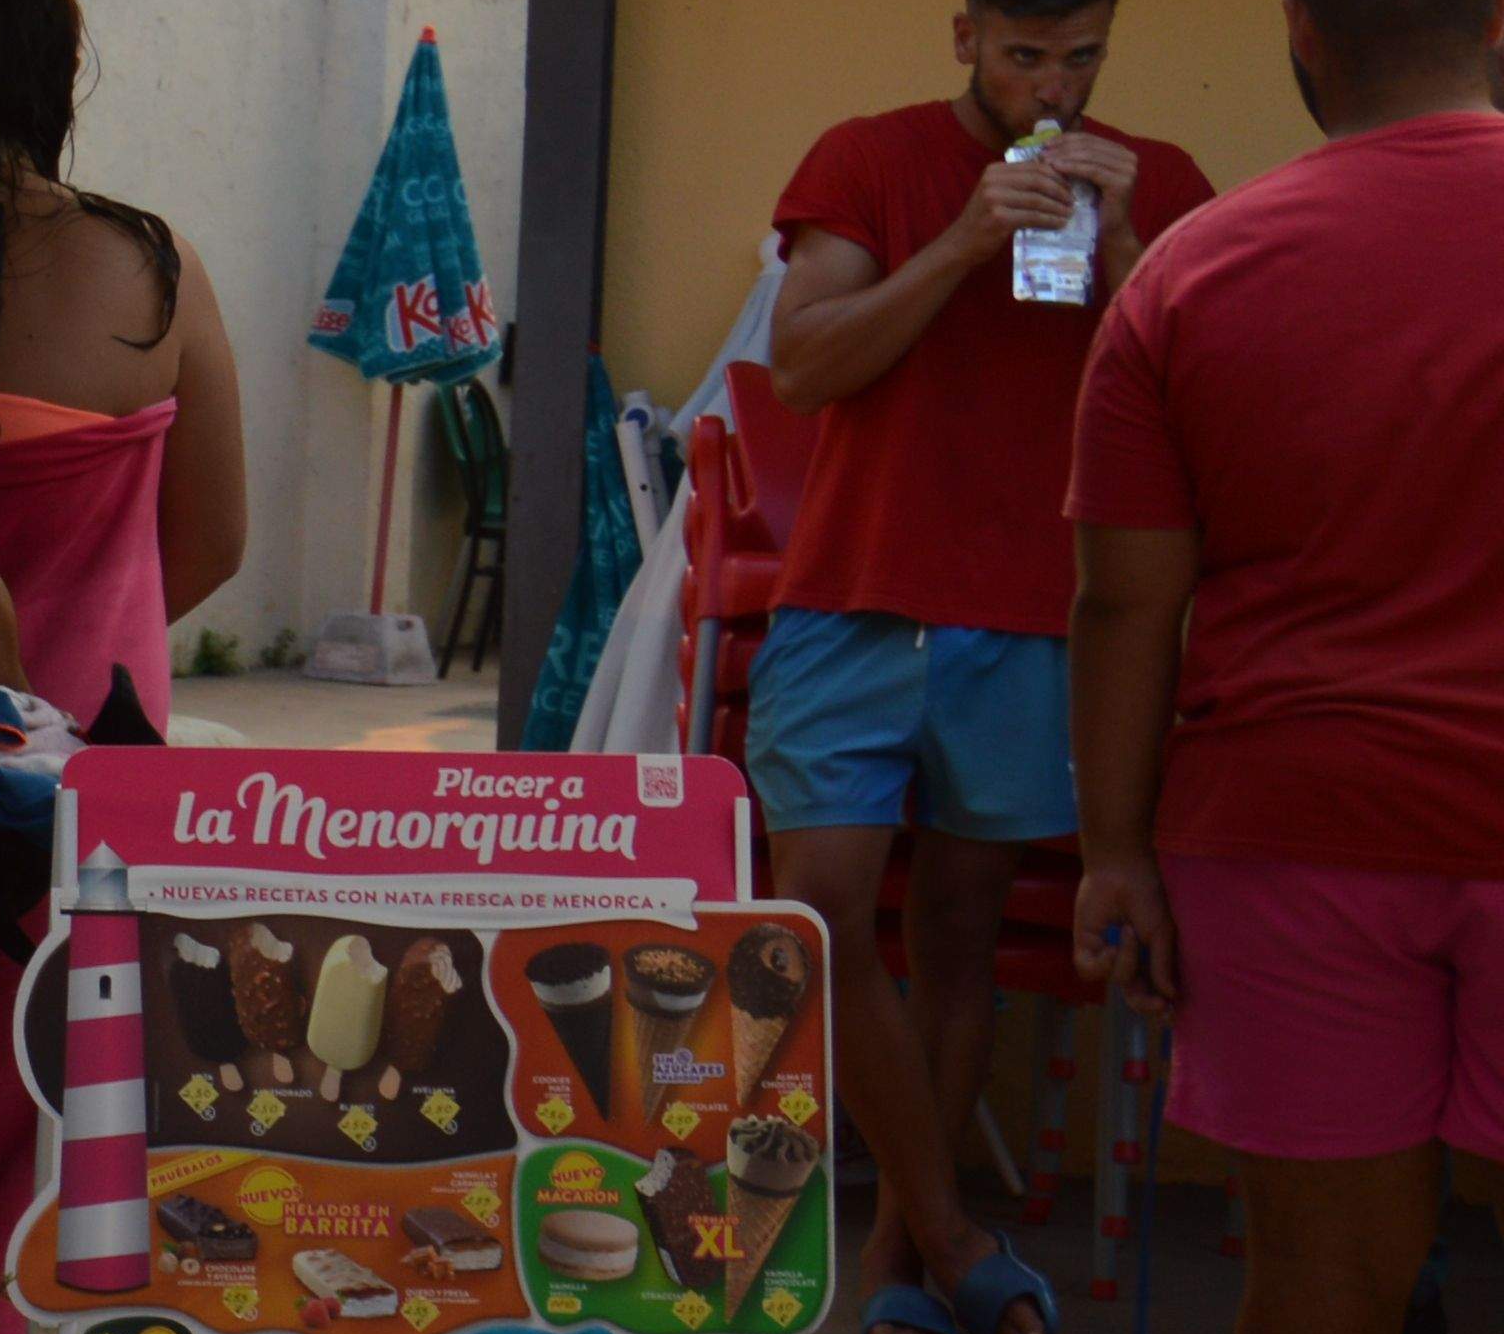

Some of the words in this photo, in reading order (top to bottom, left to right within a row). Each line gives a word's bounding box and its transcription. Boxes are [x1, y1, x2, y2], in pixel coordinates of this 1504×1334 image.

[433, 766, 548, 799] Placer
[560, 777, 585, 799] a
[174, 789, 236, 845] la
[236, 771, 637, 865] Menorquina
[162, 884, 239, 902] NUEVAS
[245, 886, 328, 904] RECETAS
[334, 888, 378, 906] CON
[384, 889, 433, 907] NATA
[440, 890, 514, 908] FRESCA
[520, 892, 547, 909] DE
[552, 892, 655, 911] MENORCA
[550, 1166, 605, 1185] NUEVO
[238, 1183, 304, 1206] NUEVOS
[284, 1202, 362, 1217] HELADOS
[366, 1203, 390, 1218] EN
[284, 1216, 390, 1238] BARRITA
[693, 1224, 746, 1260] XL
